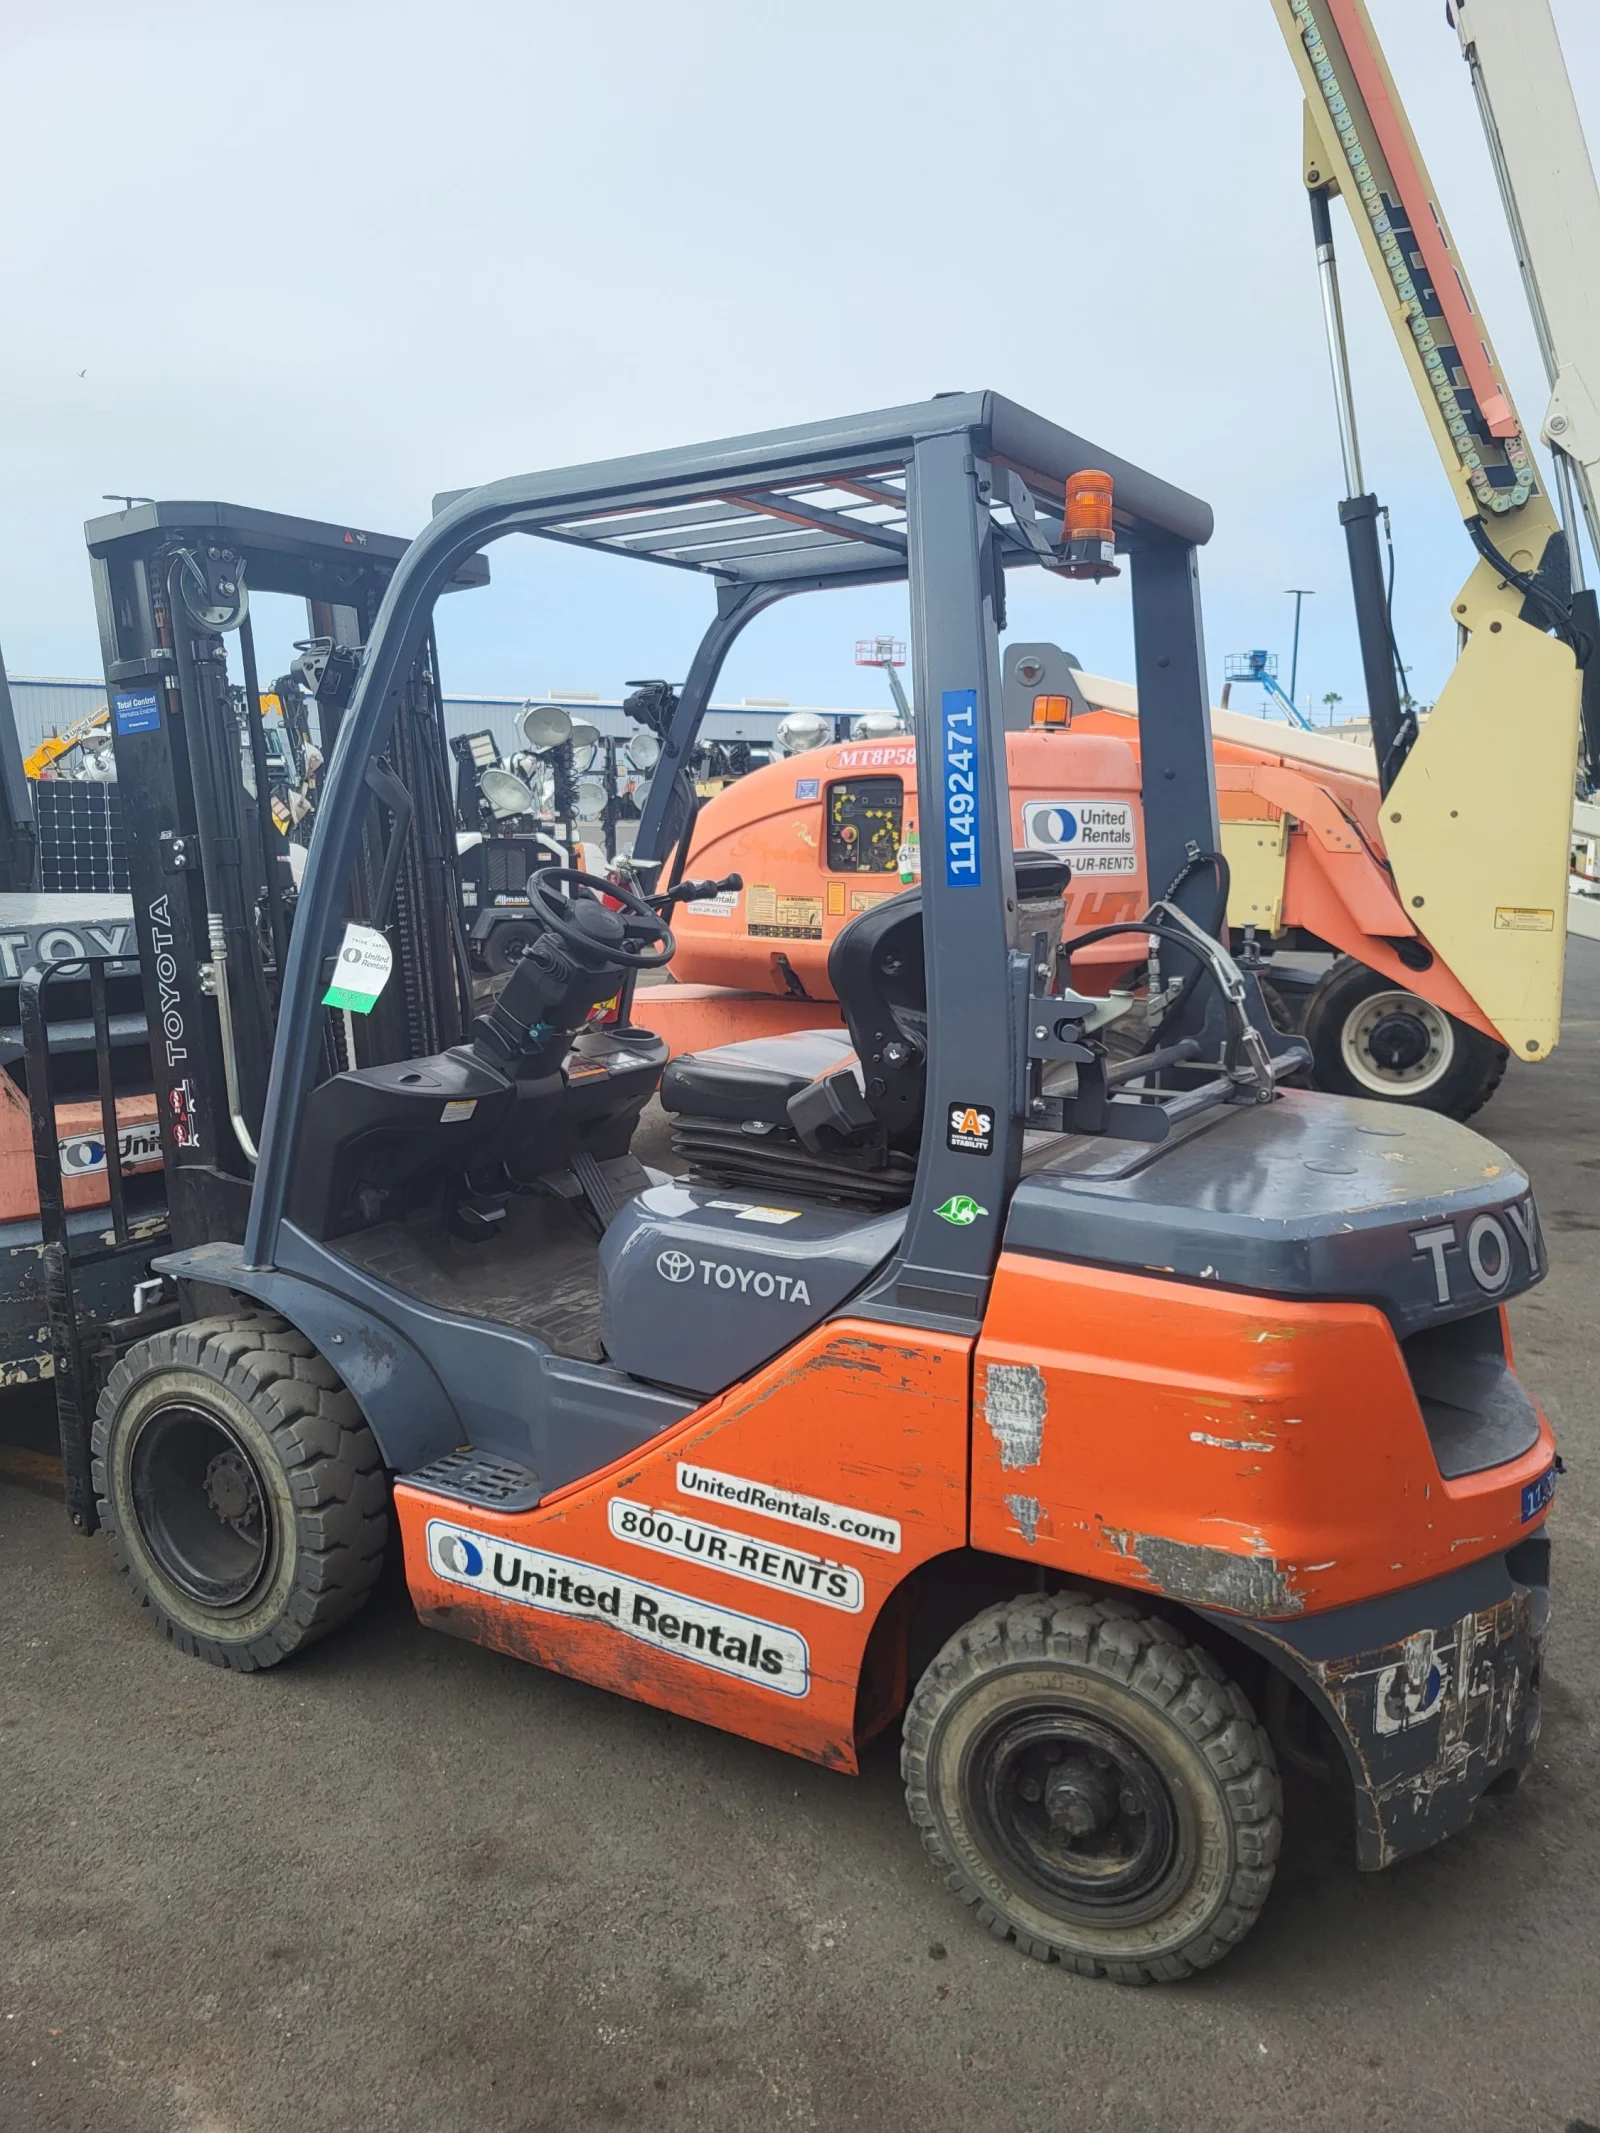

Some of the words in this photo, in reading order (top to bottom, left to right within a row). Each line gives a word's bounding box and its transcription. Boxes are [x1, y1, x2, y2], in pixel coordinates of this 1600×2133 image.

[117, 700, 132, 710] Total
[133, 695, 156, 707] Control
[140, 706, 157, 715] Enabled
[946, 706, 977, 875] 11492471
[1080, 808, 1126, 826] United
[1081, 827, 1131, 843] Rentals
[361, 959, 389, 972] Rentals
[364, 951, 390, 964] United
[149, 894, 188, 1067] TOYOTA
[951, 1108, 991, 1136] SAS
[951, 1139, 989, 1150] STABILITY
[1410, 1197, 1541, 1306] TOY
[699, 1260, 811, 1306] TOYOTA
[680, 1470, 896, 1545] UnitedRentals.com
[620, 1511, 850, 1598] 800-UR-RENTS
[493, 1552, 621, 1619] United
[632, 1594, 784, 1676] Rentals
